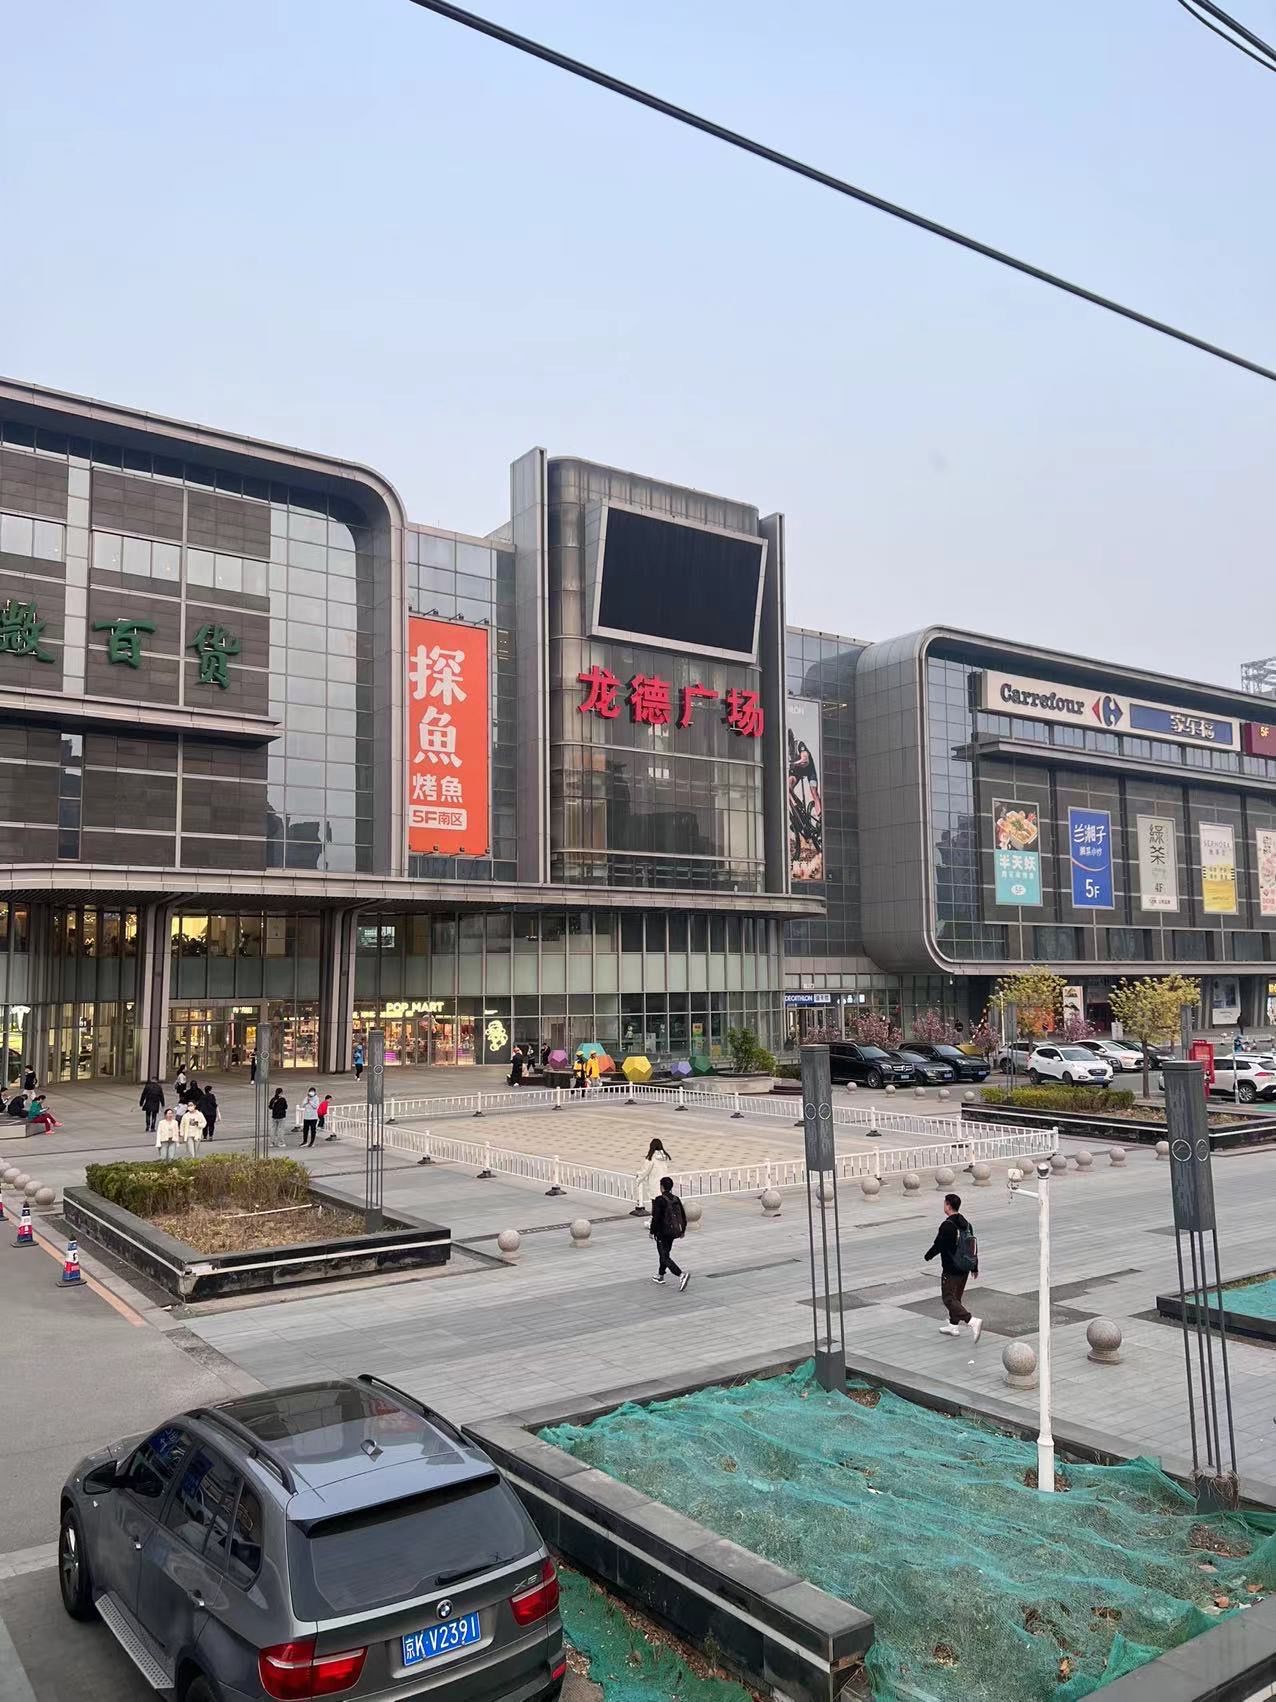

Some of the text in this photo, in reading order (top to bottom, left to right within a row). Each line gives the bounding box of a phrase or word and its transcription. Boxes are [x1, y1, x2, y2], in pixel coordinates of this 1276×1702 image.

[577, 664, 765, 738] 龙德广场
[1000, 683, 1085, 715] Carrefour
[412, 809, 464, 826] 5F南区
[1073, 824, 1107, 845] 兰湘子
[1085, 878, 1100, 899] 5F
[386, 1001, 445, 1012] POP MART
